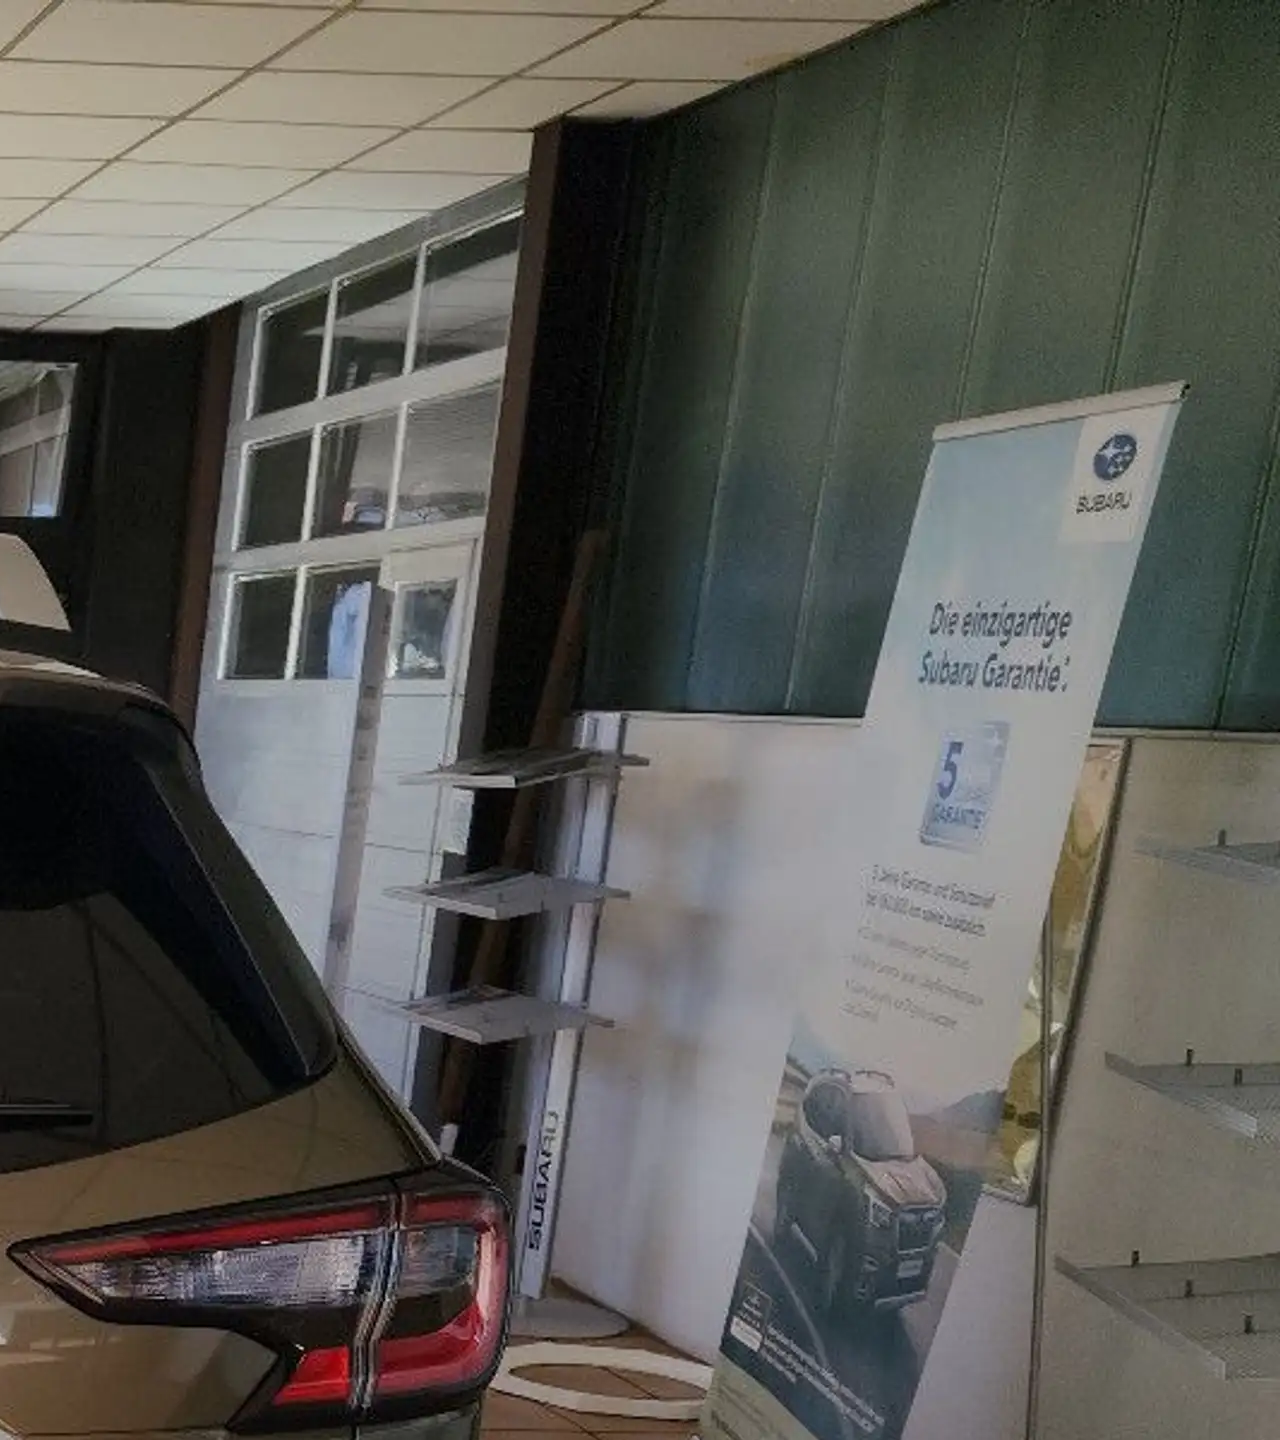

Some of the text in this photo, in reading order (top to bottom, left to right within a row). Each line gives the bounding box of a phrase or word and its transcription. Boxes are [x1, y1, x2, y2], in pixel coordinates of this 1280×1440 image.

[1076, 490, 1133, 514] SUBARU
[929, 601, 1072, 648] Die einzigartige
[918, 650, 979, 687] Subaru
[936, 741, 963, 801] 5
[528, 1111, 559, 1251] SUBARU
